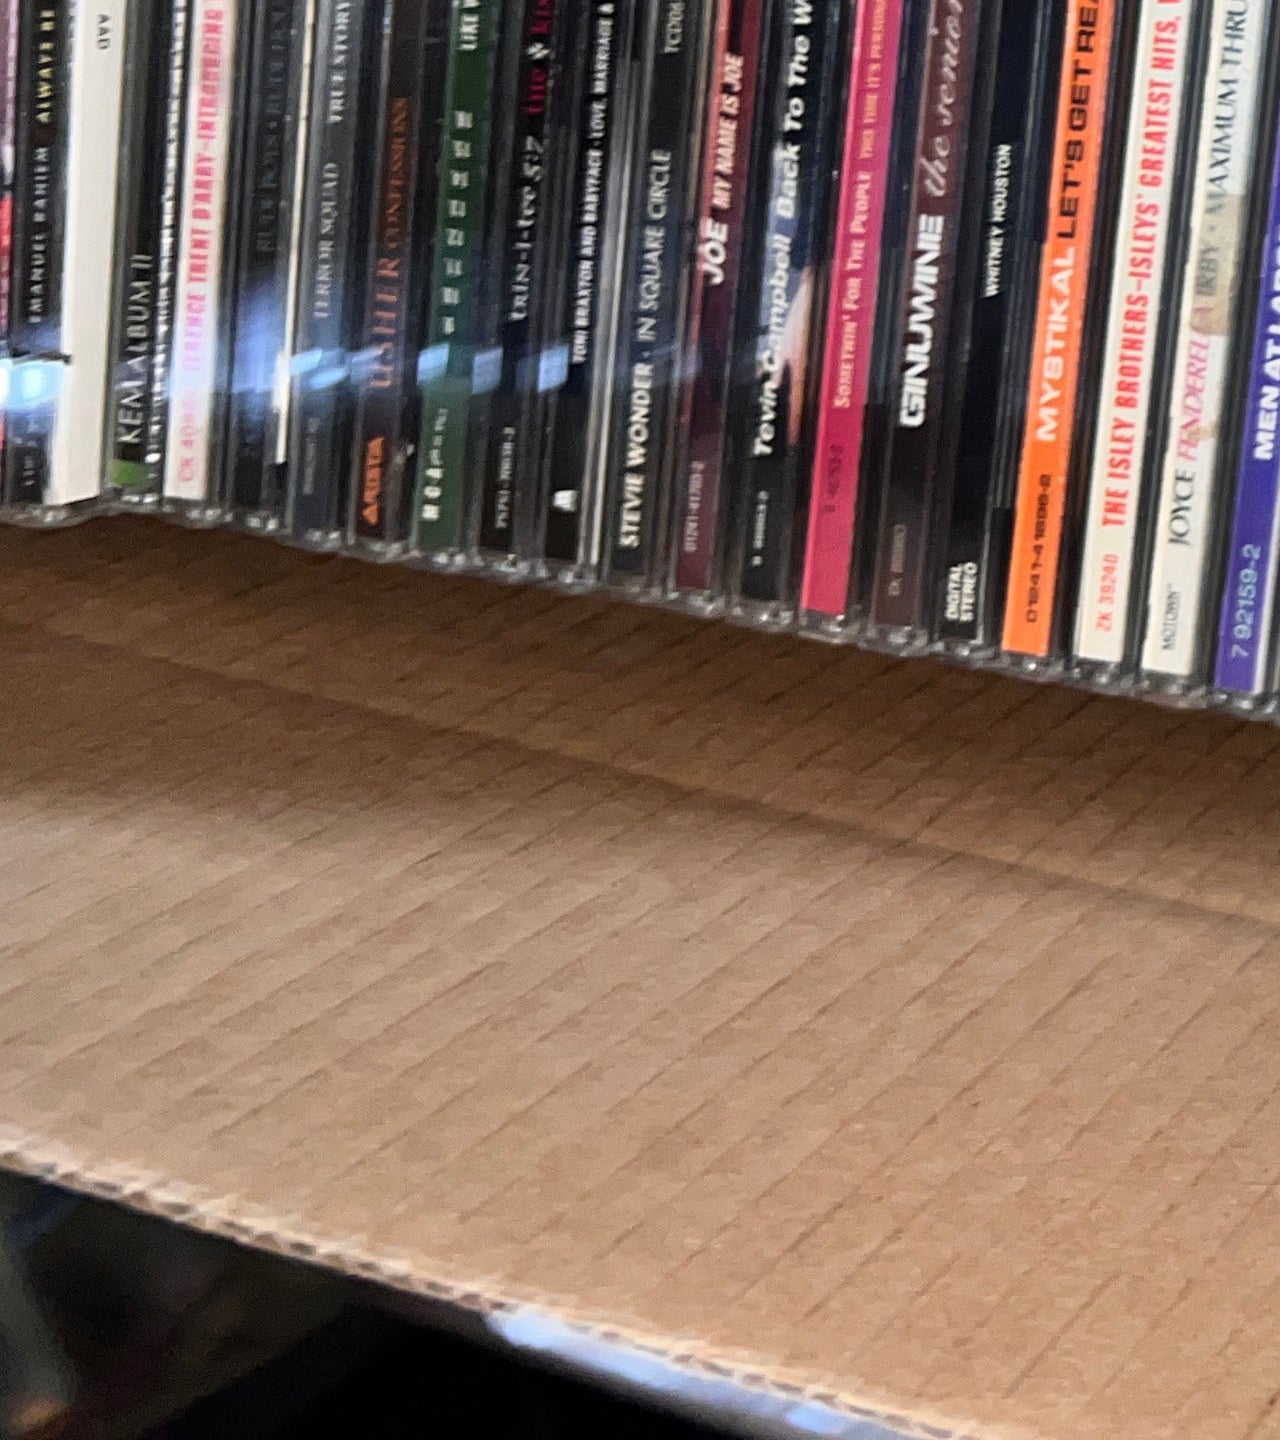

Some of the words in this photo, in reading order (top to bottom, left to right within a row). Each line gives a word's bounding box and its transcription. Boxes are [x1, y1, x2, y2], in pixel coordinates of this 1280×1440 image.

[96, 14, 111, 49] AAD
[460, 13, 479, 51] LIKE
[786, 34, 810, 87] The
[35, 41, 54, 122] ALWAYS
[723, 52, 744, 91] JOE
[1069, 57, 1092, 132] GET
[715, 117, 737, 174] NAME
[772, 141, 801, 219] Back
[917, 134, 950, 196] the
[991, 143, 1012, 221] HOUSTON
[319, 162, 339, 235] SQUAD
[646, 150, 671, 219] CIRCLE
[849, 171, 872, 233] PEOPLE
[1057, 138, 1083, 239] LET'S
[580, 224, 597, 256] AND
[638, 226, 666, 310] SQUARE
[697, 217, 728, 286] JOE
[984, 225, 1004, 297] WHITNEY
[123, 280, 150, 373] ALBUM
[366, 255, 399, 389] USHER
[898, 213, 944, 427] GINUWINE
[1035, 245, 1075, 441] MYSTIKAL
[626, 362, 654, 466] WONDER
[1253, 385, 1280, 460] MEN
[619, 473, 644, 547] STEVIE
[1167, 471, 1195, 545] JOYCE
[946, 563, 963, 621] DIGITAL
[959, 561, 977, 621] STEREO
